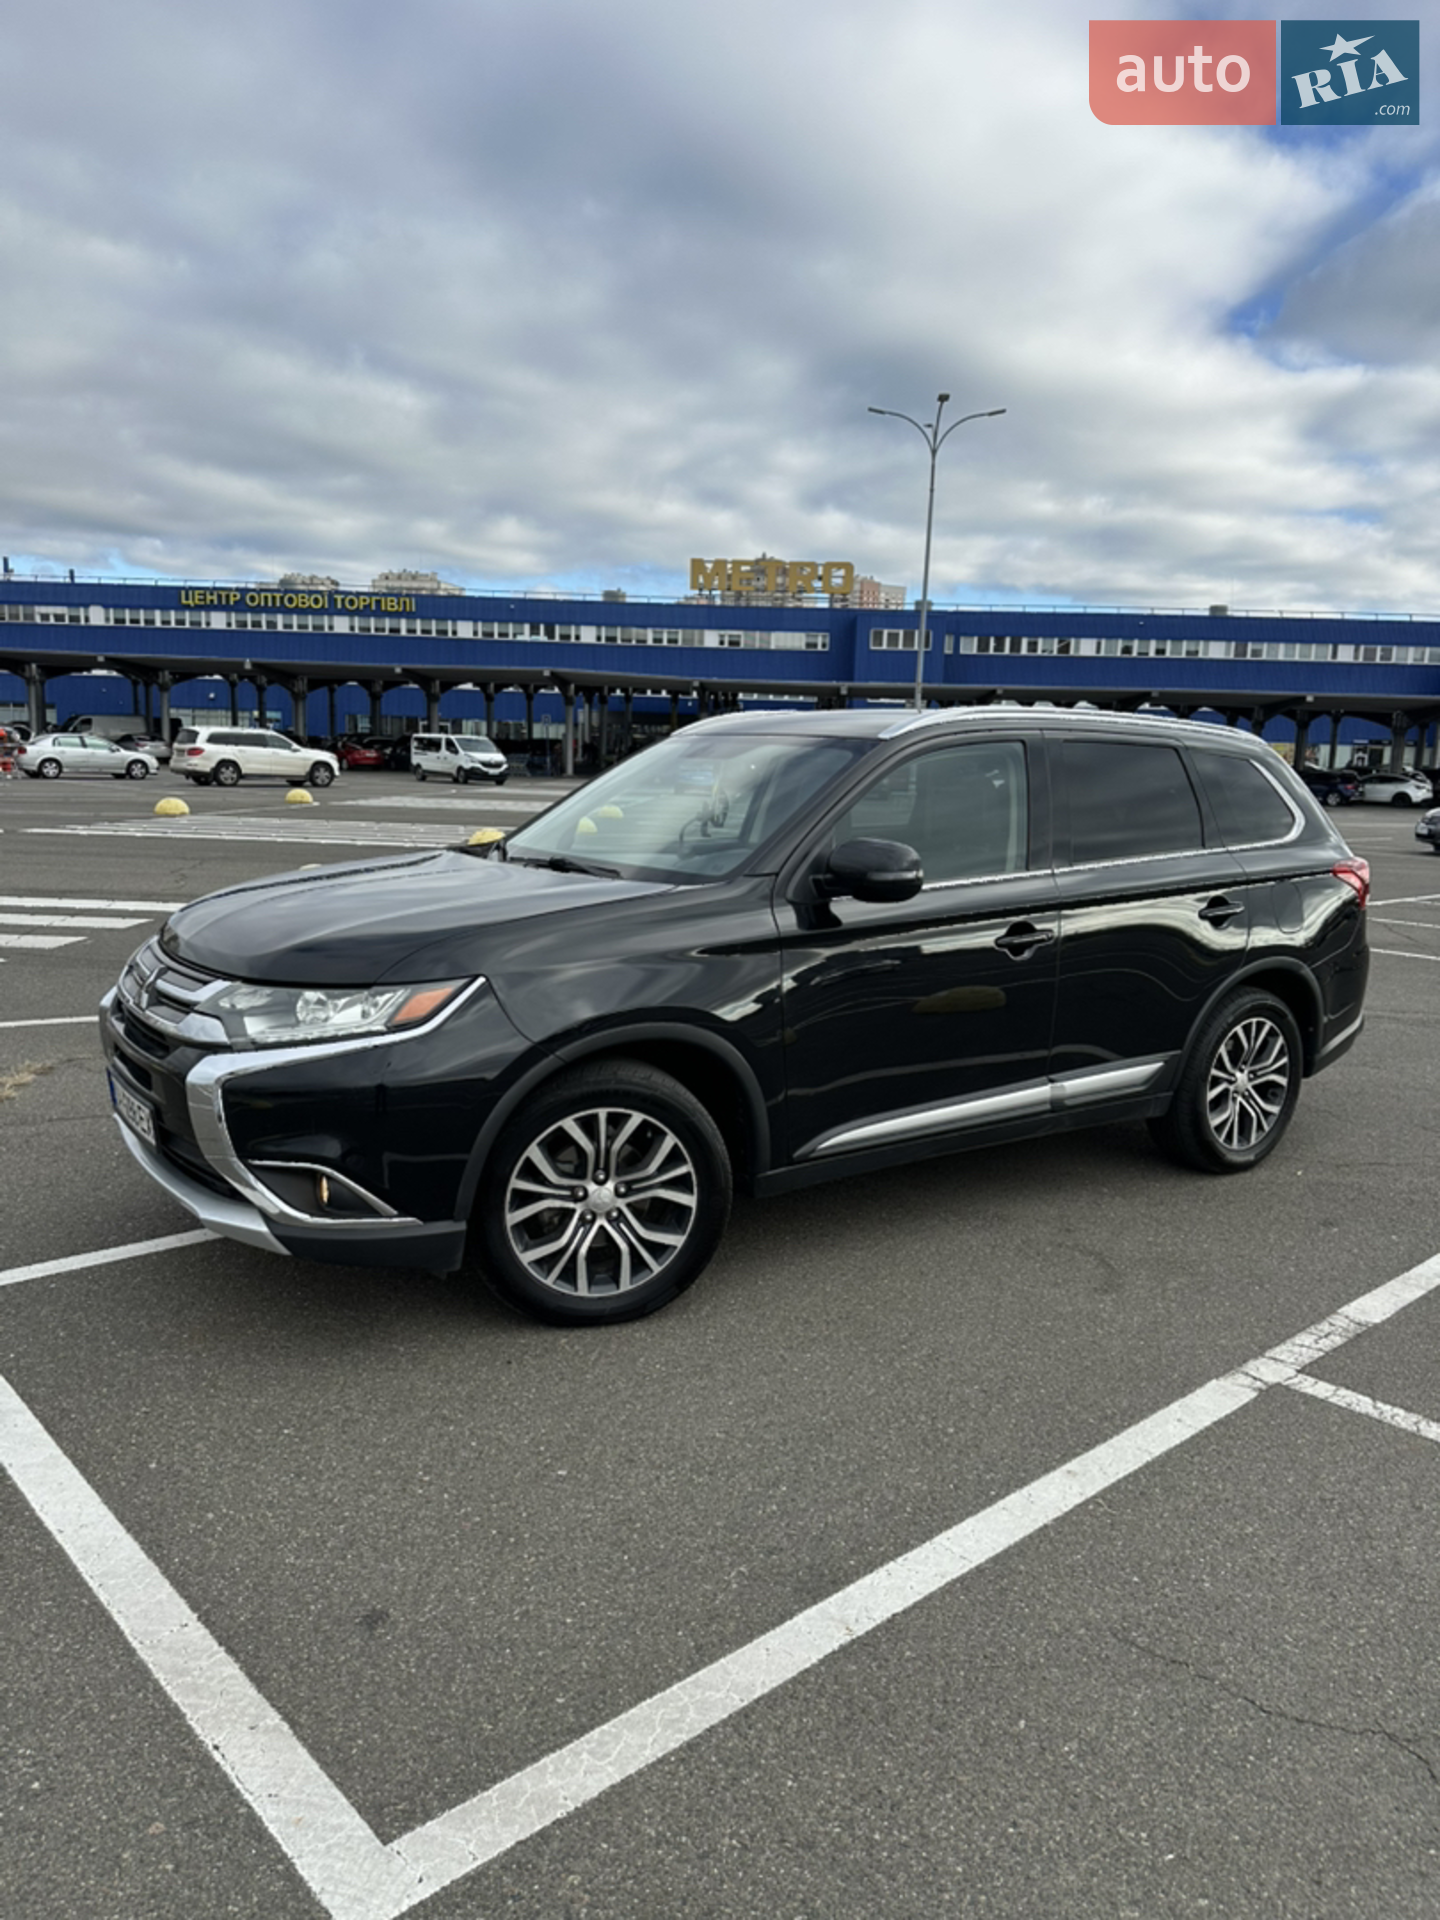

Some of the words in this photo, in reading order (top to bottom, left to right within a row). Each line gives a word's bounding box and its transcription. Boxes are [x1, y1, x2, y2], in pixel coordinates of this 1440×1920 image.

[690, 558, 855, 595] METRO
[181, 590, 241, 606] ЦЕНТР
[245, 592, 329, 609] ОПТОВОЇ
[334, 595, 416, 612] ТОРГІВЛІ
